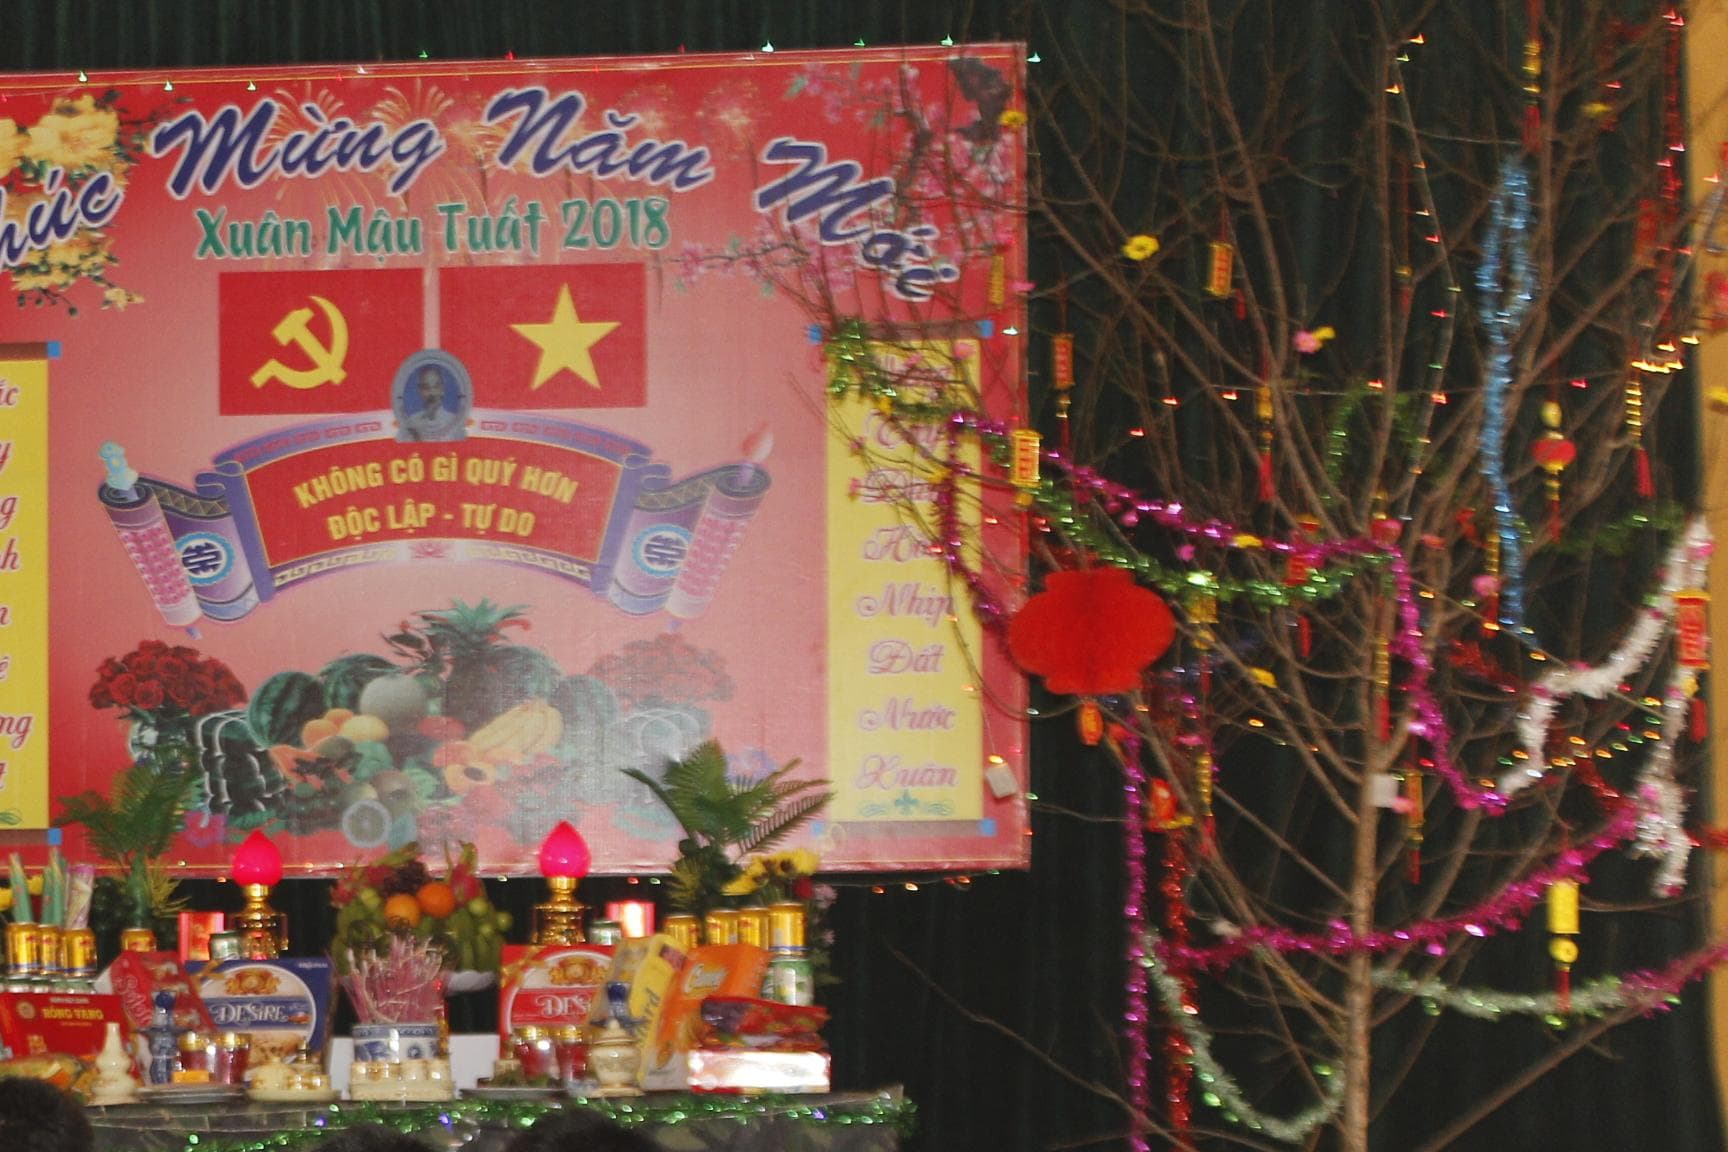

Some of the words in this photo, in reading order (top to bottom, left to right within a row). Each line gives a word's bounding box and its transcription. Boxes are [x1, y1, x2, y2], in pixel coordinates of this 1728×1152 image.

[152, 98, 443, 197] Mừng
[487, 87, 713, 190] Năm
[756, 138, 958, 300] Mới
[195, 208, 311, 258] Xuân
[327, 205, 421, 262] Mậu
[437, 196, 546, 256] Tuất
[562, 197, 670, 250] 2018
[293, 463, 384, 509] KHÔNG
[390, 452, 424, 484] CÓ
[431, 451, 458, 482] GÌ
[465, 457, 517, 486] QUÝ
[520, 465, 579, 504] HƠN
[327, 506, 381, 540] ĐỘC
[386, 498, 436, 533] LẬP
[460, 503, 497, 535] TỰ
[498, 508, 536, 537] DO
[856, 754, 959, 789] Xuân
